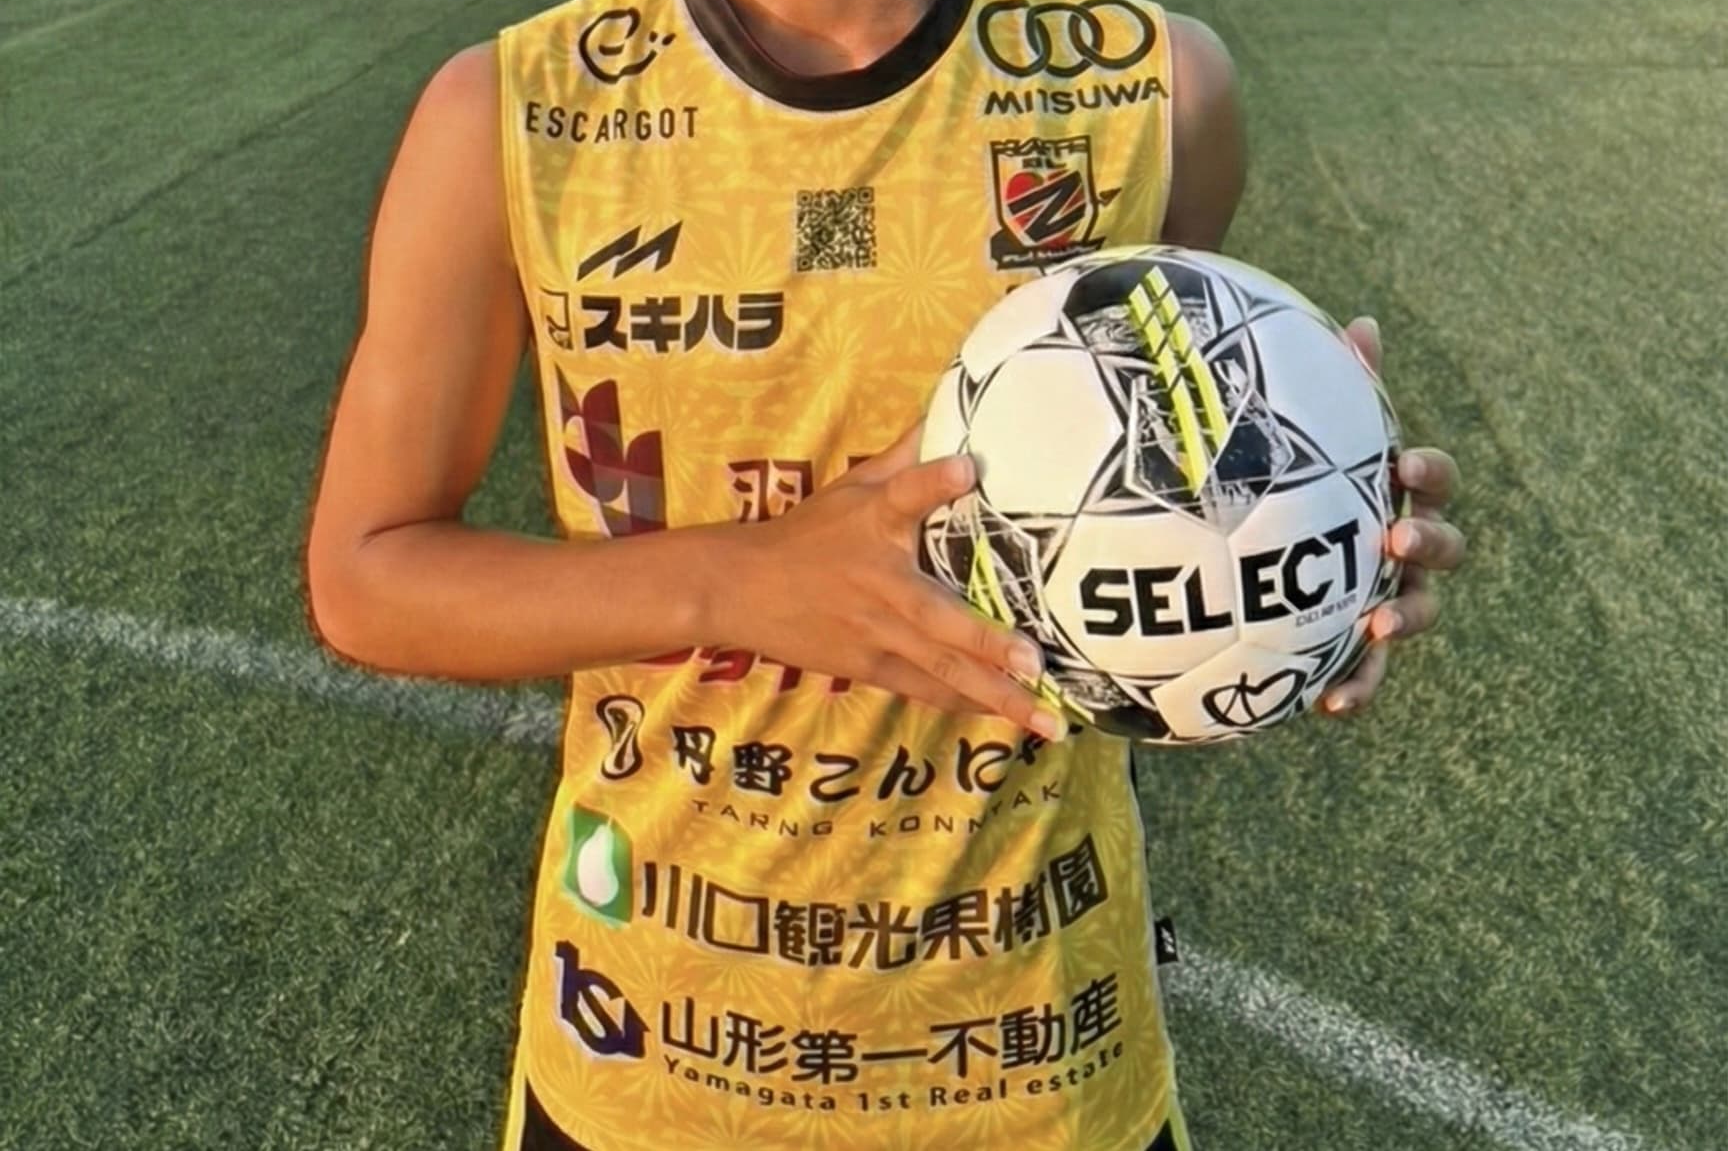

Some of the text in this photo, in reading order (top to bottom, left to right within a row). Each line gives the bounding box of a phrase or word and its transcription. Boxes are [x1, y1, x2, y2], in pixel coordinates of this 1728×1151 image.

[525, 101, 699, 143] ESCARGOT
[1080, 520, 1361, 636] SELECT
[640, 832, 1109, 970] 川口観光果樹園
[662, 971, 1122, 1085] 山形第一不動産
[663, 1040, 1123, 1112] Yamagata 1st Real estate
